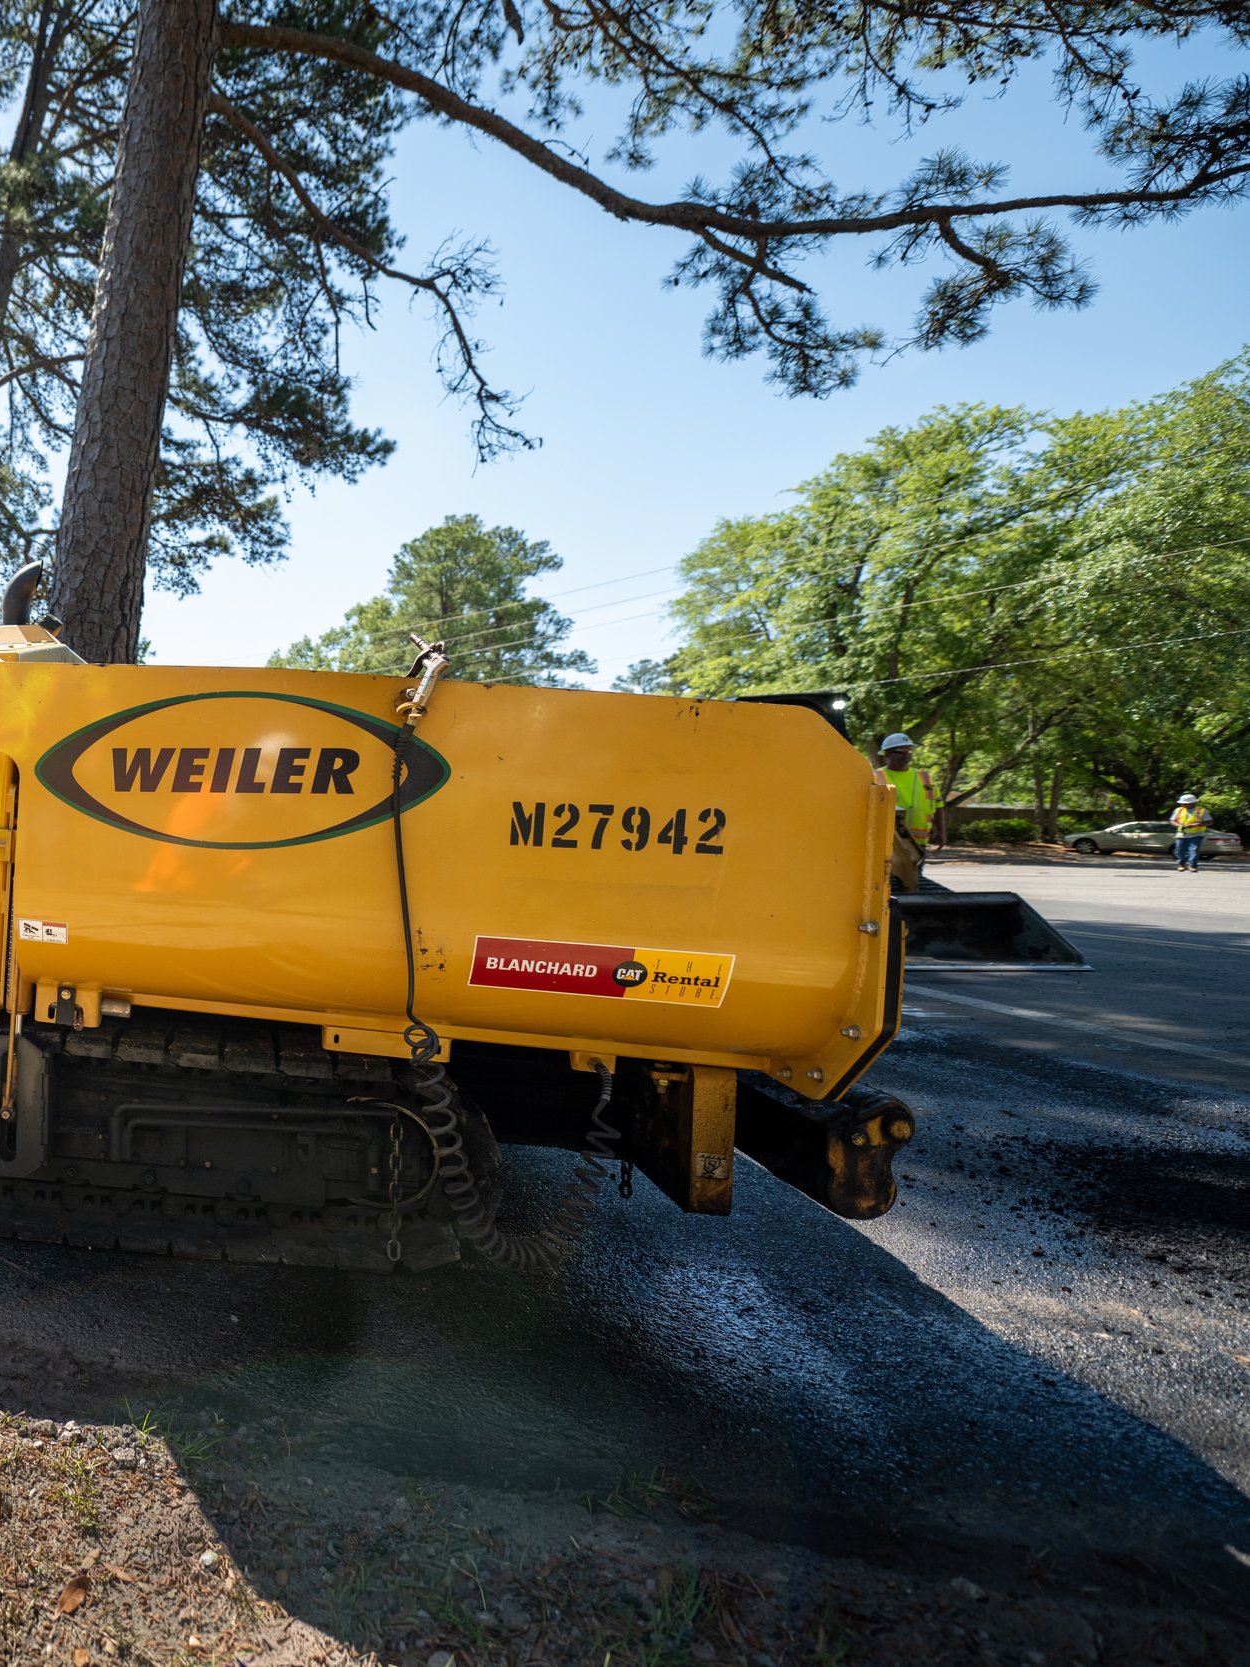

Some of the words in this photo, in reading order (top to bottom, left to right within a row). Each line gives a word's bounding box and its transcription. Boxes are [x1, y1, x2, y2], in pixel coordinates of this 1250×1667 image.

[112, 747, 360, 795] WEILER
[510, 801, 726, 855] M27942
[486, 957, 598, 978] BLANCHARD
[616, 968, 643, 980] CAT
[651, 971, 720, 988] Rental
[650, 984, 717, 999] STORE
